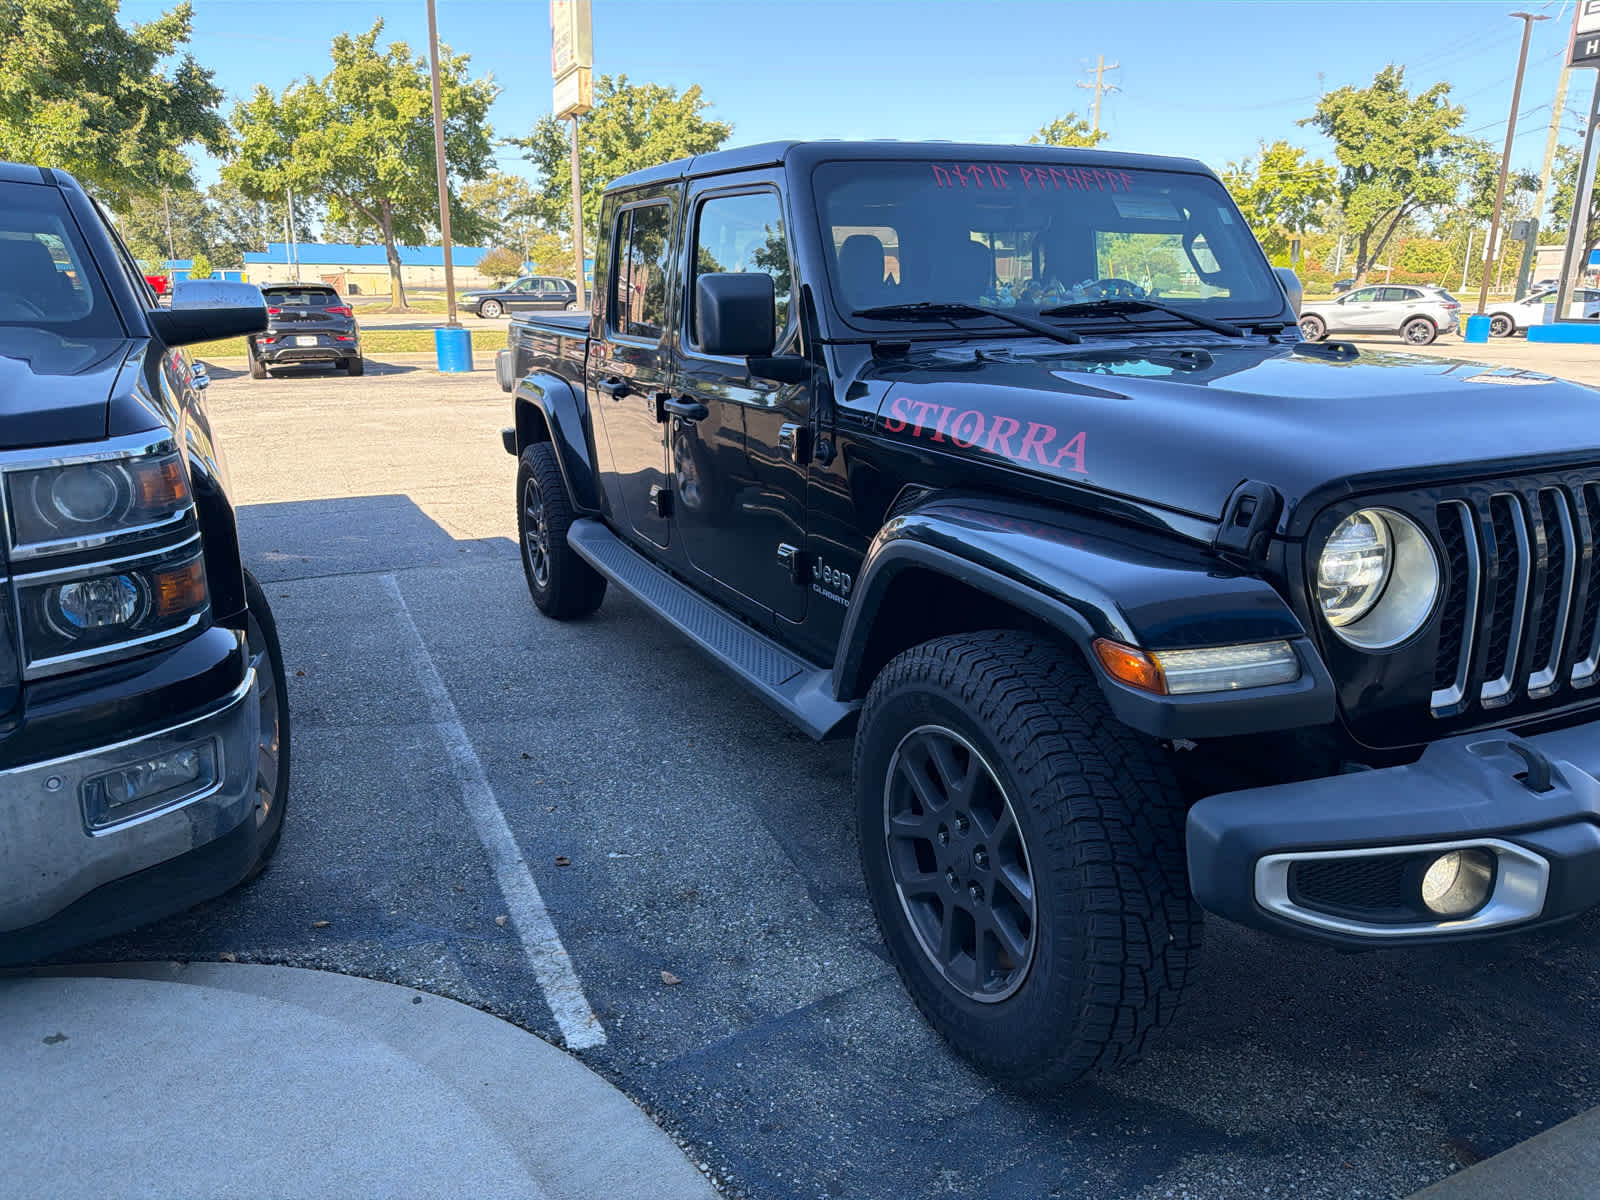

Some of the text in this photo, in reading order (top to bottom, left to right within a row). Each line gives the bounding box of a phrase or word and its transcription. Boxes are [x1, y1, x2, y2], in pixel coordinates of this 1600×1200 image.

[884, 397, 1088, 474] STIORRA
[812, 556, 852, 595] Jeep
[812, 583, 850, 607] GLADIATO
